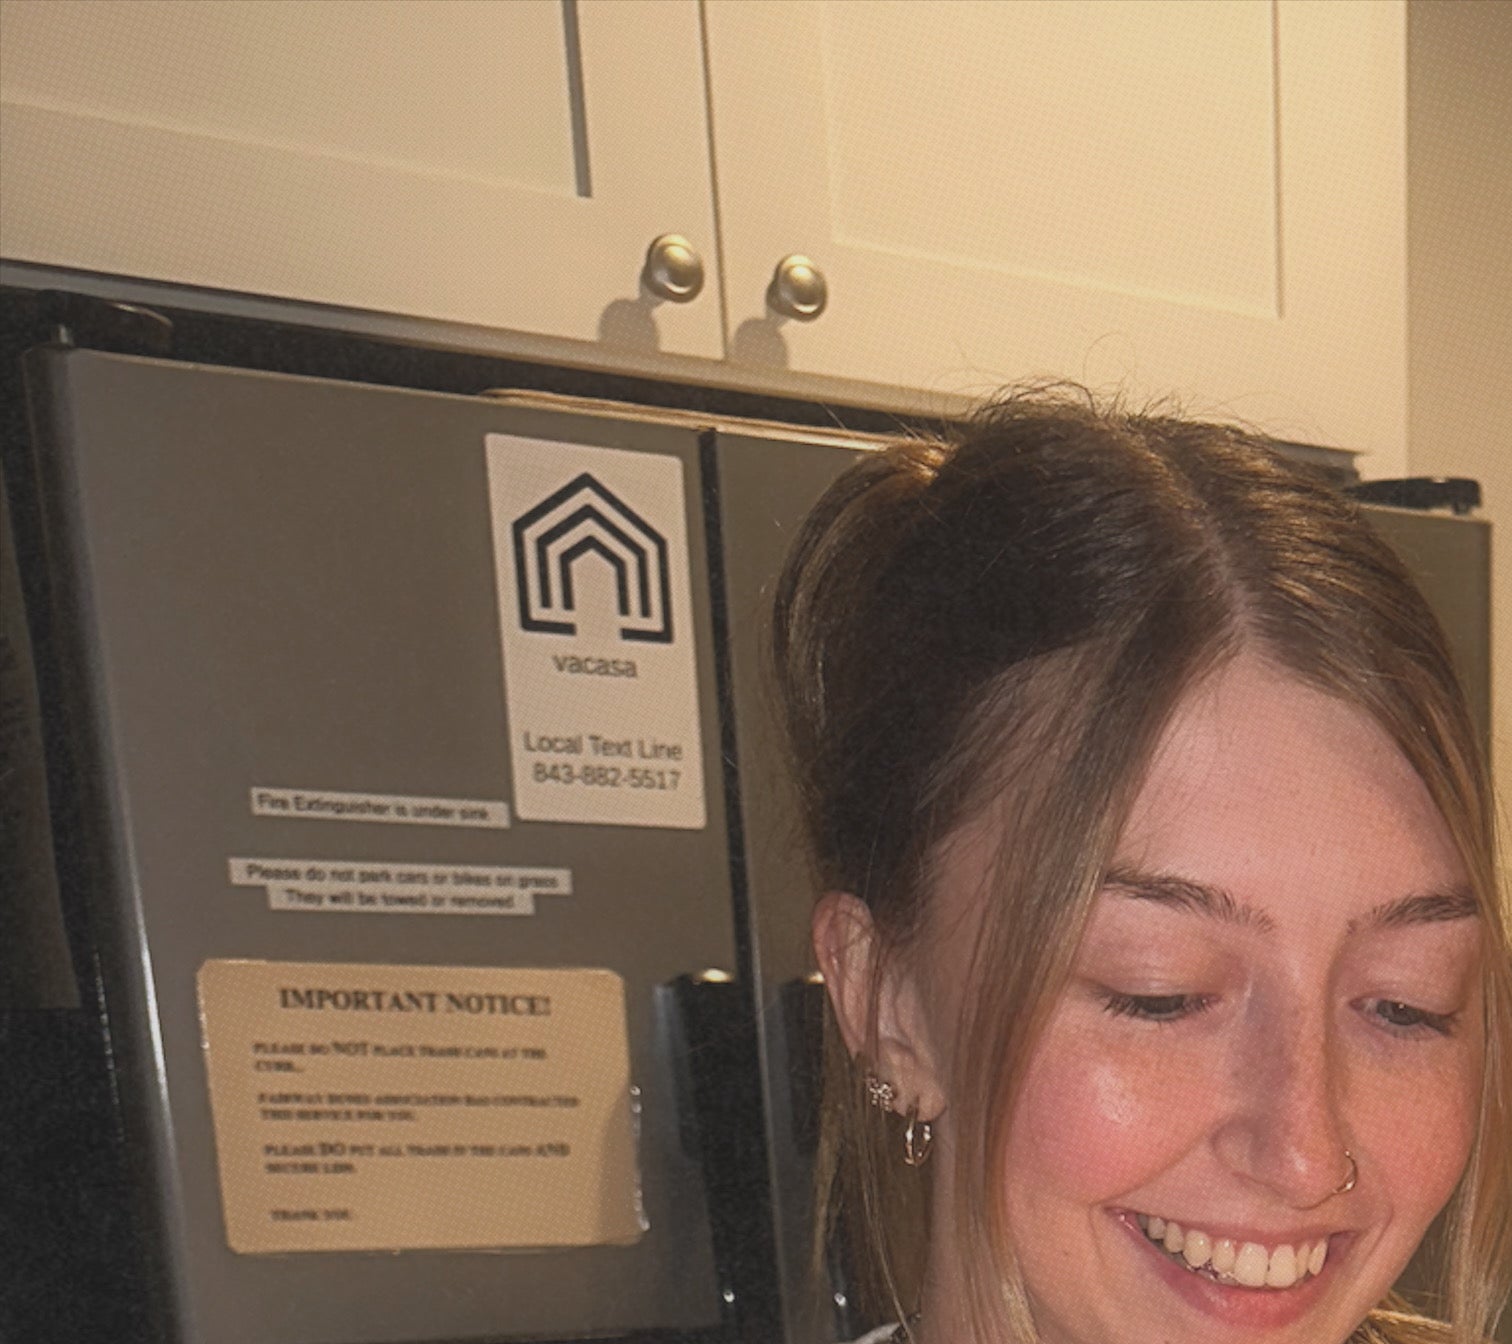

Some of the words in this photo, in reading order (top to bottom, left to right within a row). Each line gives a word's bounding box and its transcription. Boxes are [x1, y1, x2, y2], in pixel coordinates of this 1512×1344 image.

[552, 655, 638, 679] vacasa
[523, 731, 584, 755] Local
[588, 734, 632, 758] Text
[638, 739, 683, 761] Line
[533, 761, 682, 791] 843-882-5517
[257, 792, 290, 810] Fire
[294, 795, 387, 815] Extinguisher
[396, 804, 408, 817] is
[411, 805, 454, 819] under
[246, 863, 300, 881] Please
[305, 866, 326, 881] do
[330, 869, 355, 883] not
[358, 869, 392, 885] park
[396, 872, 429, 885] cars
[433, 874, 448, 885] or
[452, 873, 492, 887] bikes
[496, 876, 513, 888] on
[284, 887, 324, 906] They
[329, 890, 355, 905] will
[358, 891, 378, 906] be
[381, 892, 427, 907] towed
[431, 896, 447, 908] or
[279, 988, 437, 1013] IMPORTANT
[446, 992, 552, 1016] NOTICE!
[253, 1042, 305, 1055] PLEASE
[309, 1043, 328, 1056] DO
[331, 1041, 368, 1057] NOT
[264, 1144, 315, 1157] PLEASE
[319, 1141, 346, 1157] DO
[536, 1143, 571, 1158] AND
